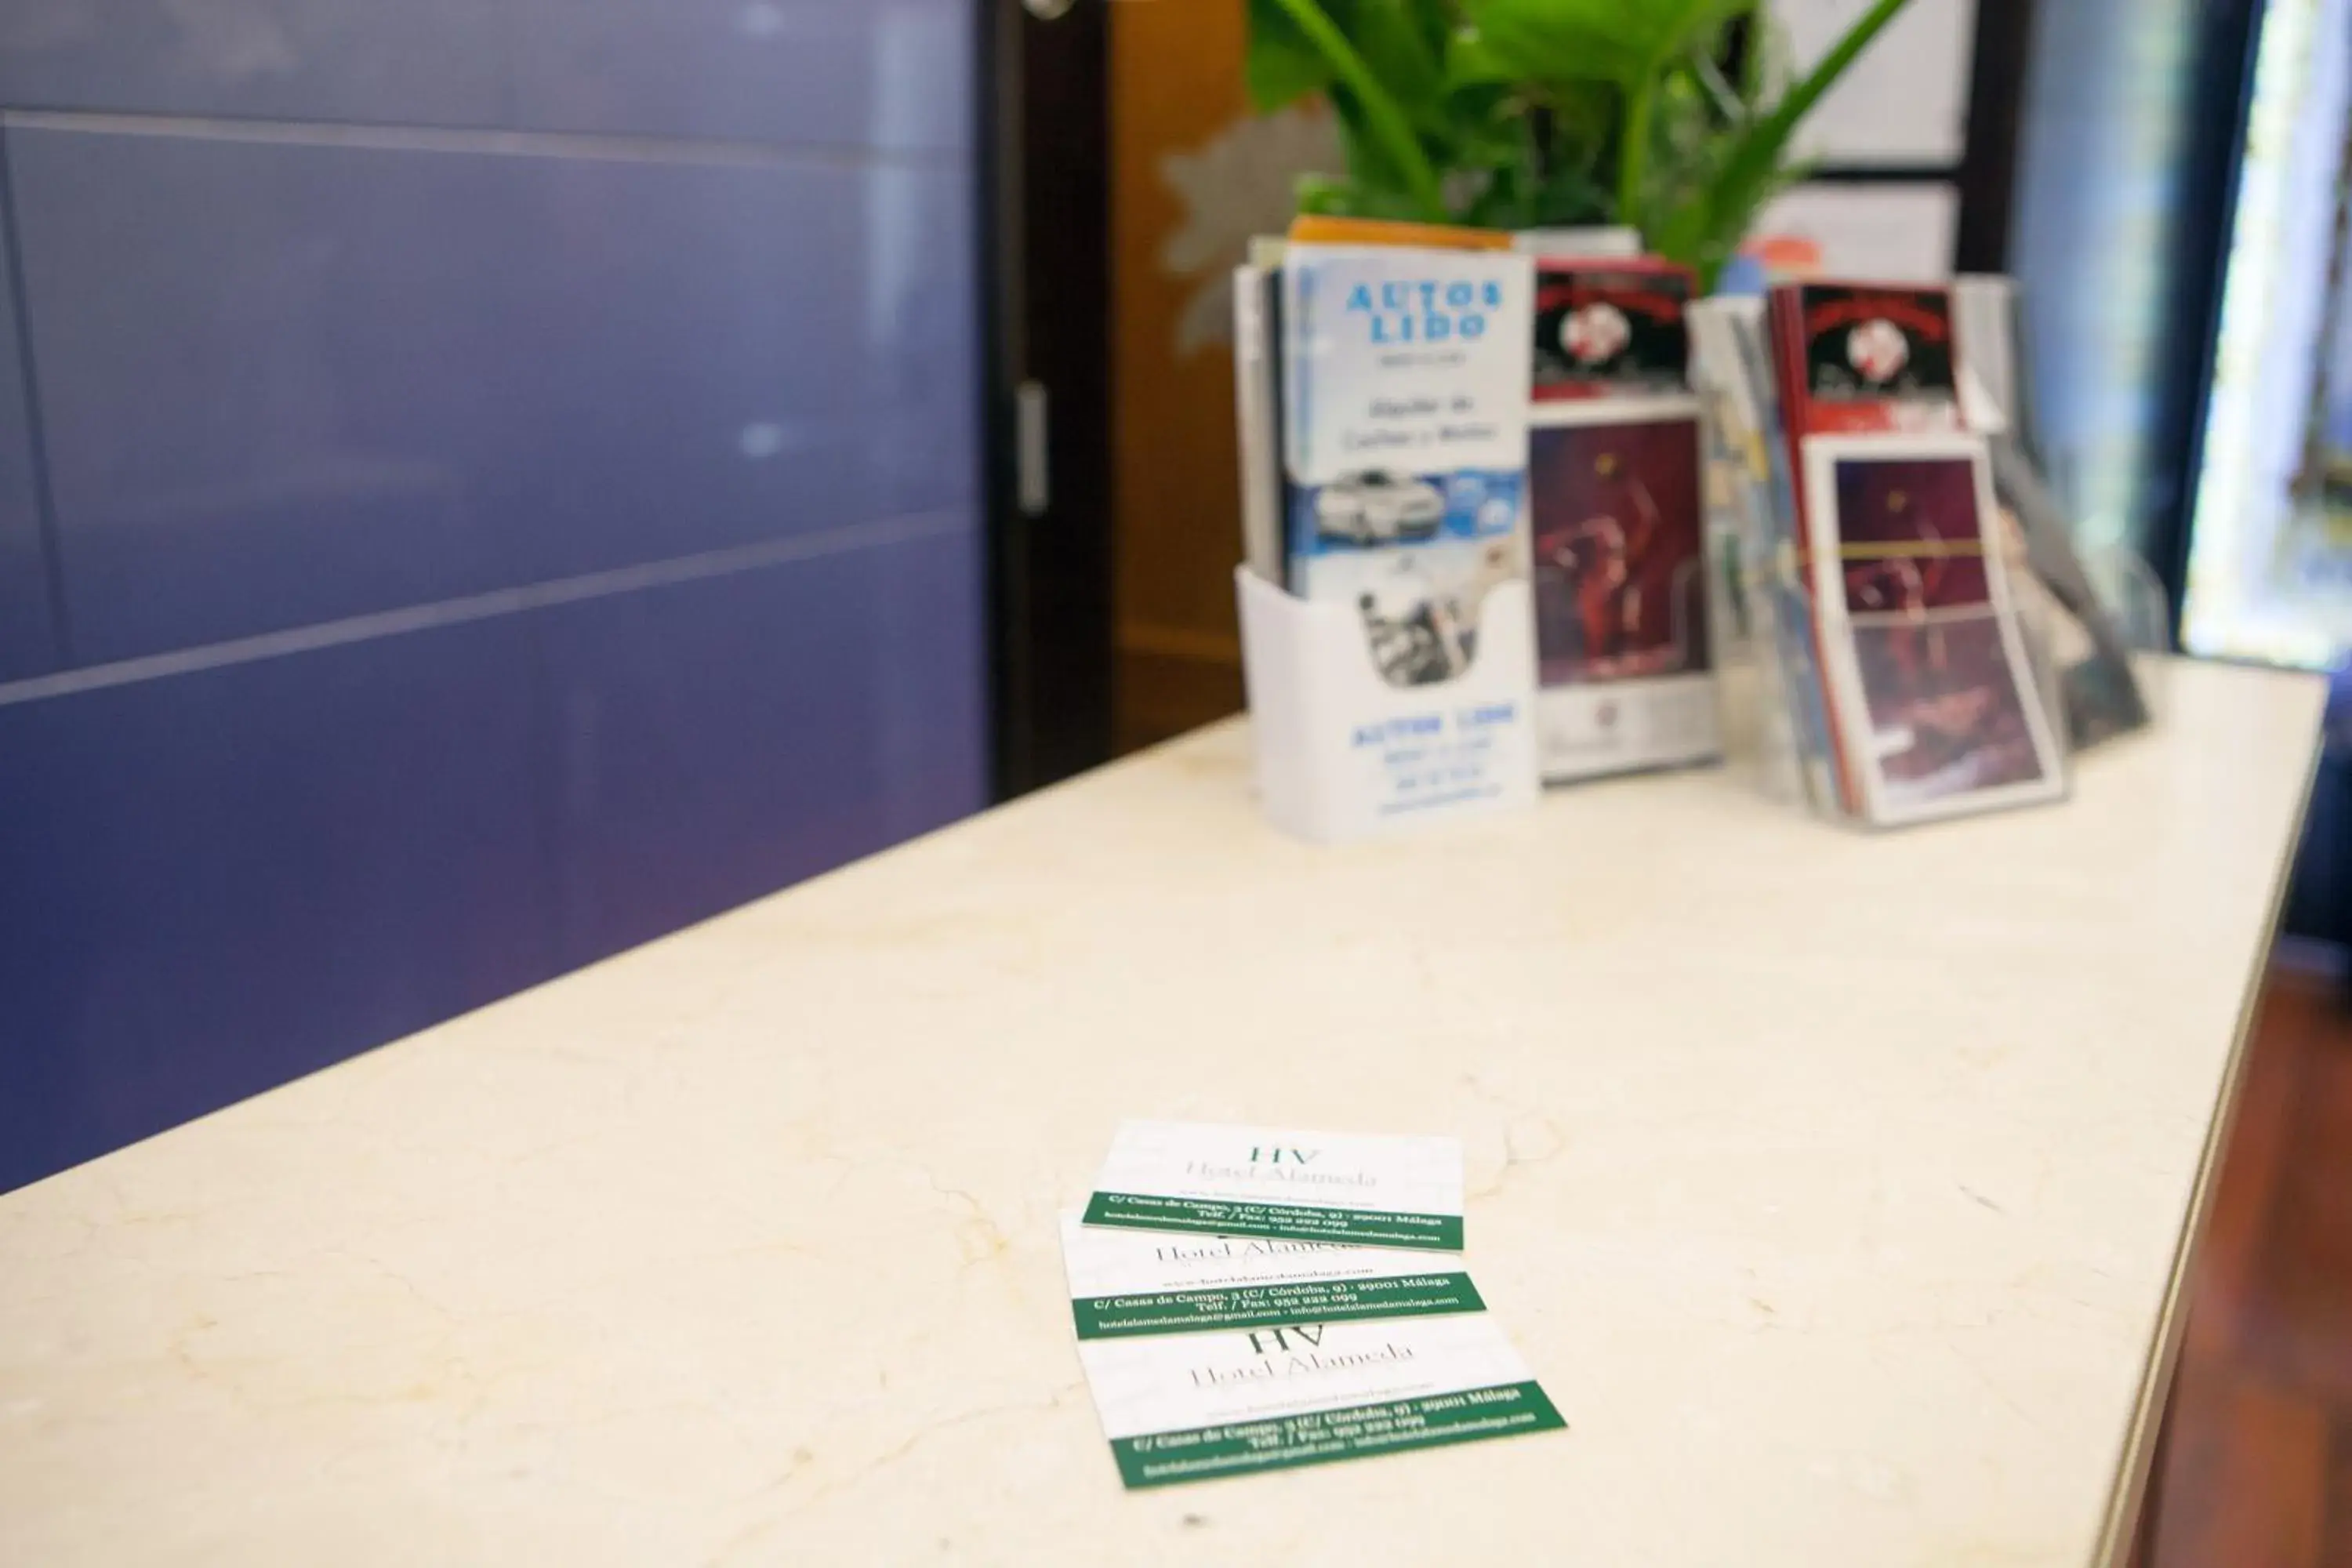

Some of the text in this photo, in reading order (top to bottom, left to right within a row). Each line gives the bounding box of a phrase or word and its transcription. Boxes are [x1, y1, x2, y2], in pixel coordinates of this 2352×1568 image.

[1346, 280, 1502, 311] AUTOS
[1370, 314, 1485, 343] LIDO
[1186, 1160, 1257, 1178] Hotel
[1251, 1145, 1321, 1165] HV
[1127, 1196, 1163, 1207] Casas
[1165, 1198, 1181, 1207] de
[1156, 1242, 1231, 1261] Hotel
[1094, 1299, 1110, 1310] C/
[1114, 1297, 1154, 1308] Casas
[1156, 1295, 1174, 1305] de
[1402, 1276, 1450, 1289] Málaga
[1247, 1323, 1323, 1354] HV
[1190, 1342, 1414, 1386] Hotel Alameda
